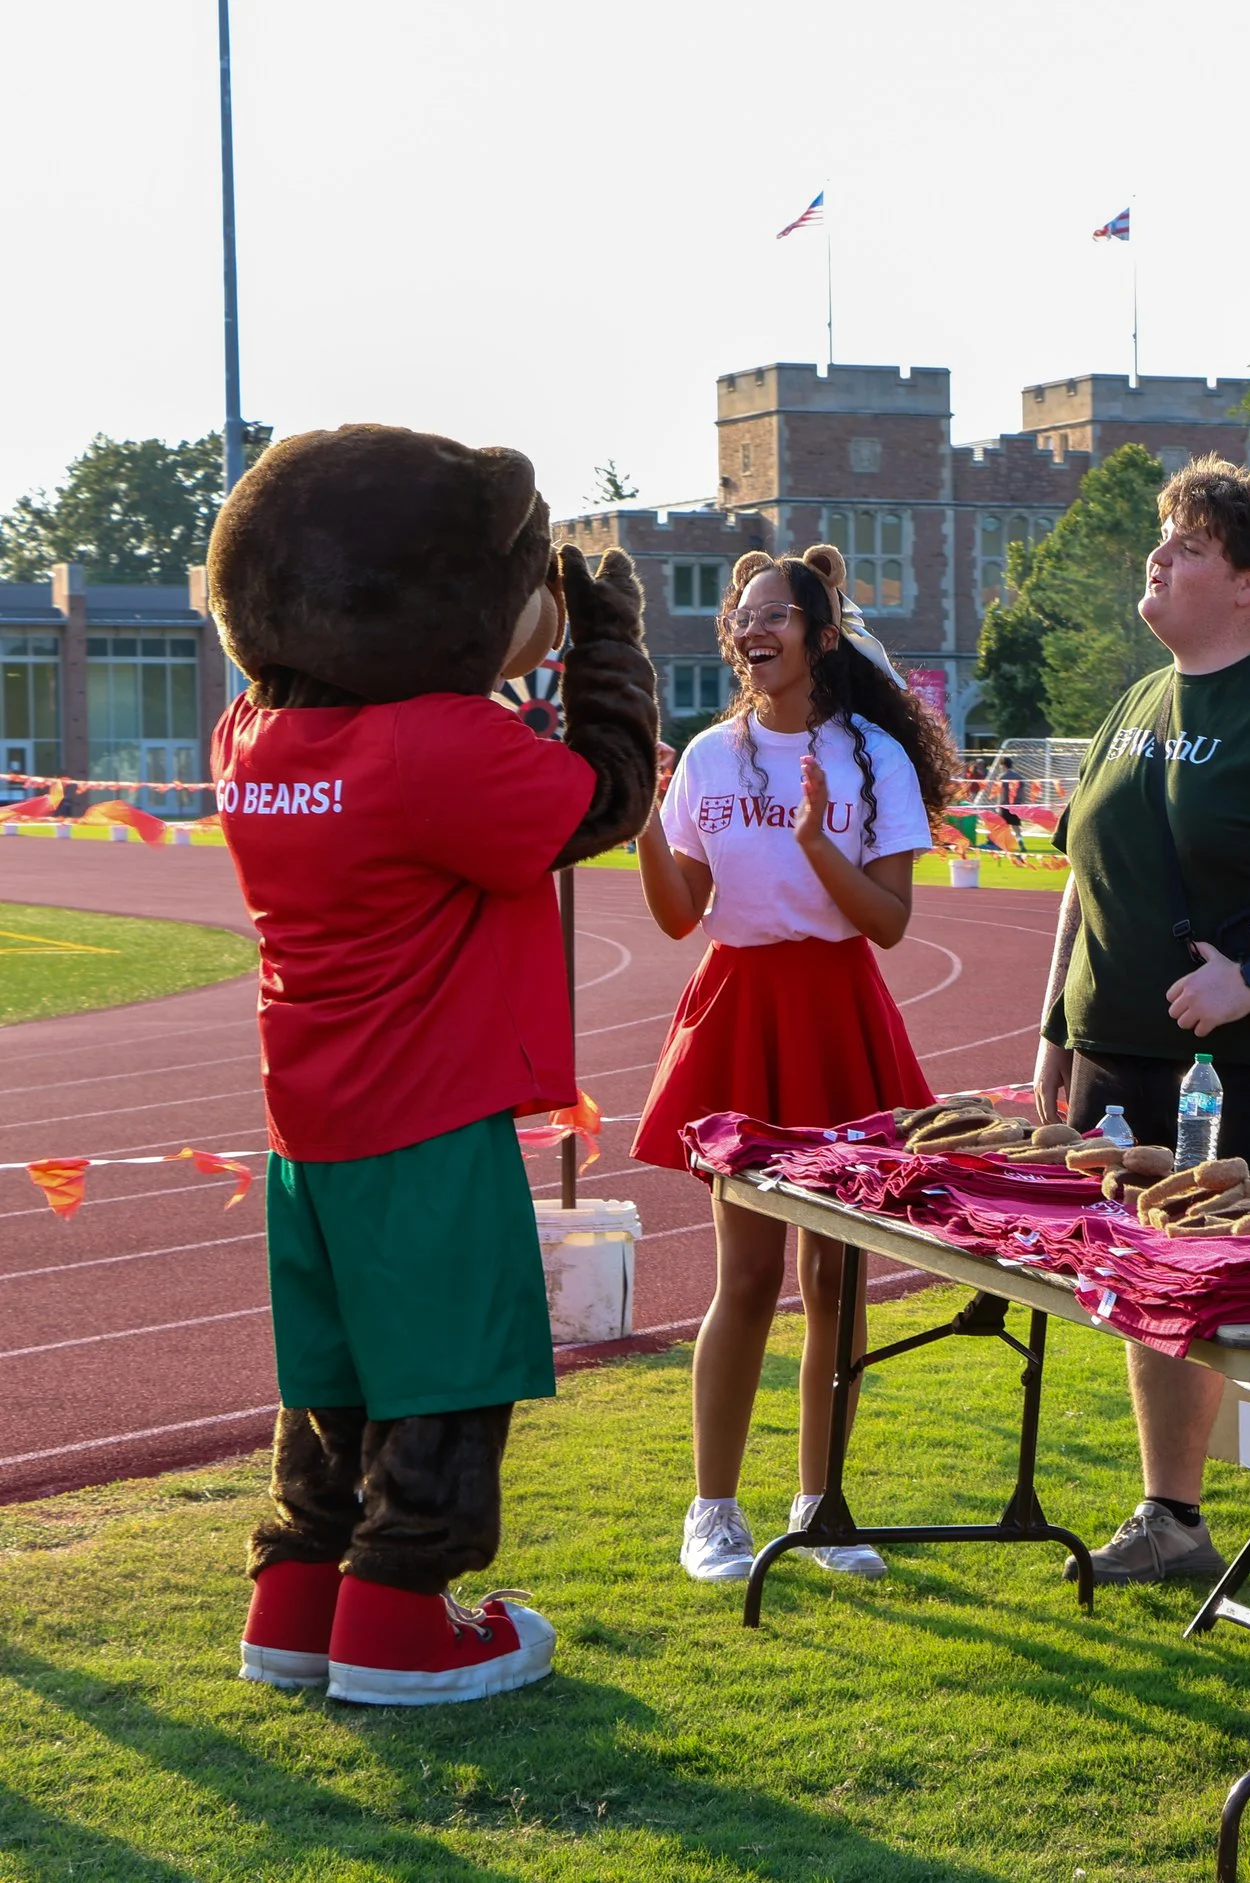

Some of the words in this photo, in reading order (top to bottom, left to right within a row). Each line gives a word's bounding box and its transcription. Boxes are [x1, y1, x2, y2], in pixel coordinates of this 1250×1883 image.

[216, 779, 239, 813] GO
[243, 780, 343, 814] BEARS!
[738, 795, 853, 834] WasU
